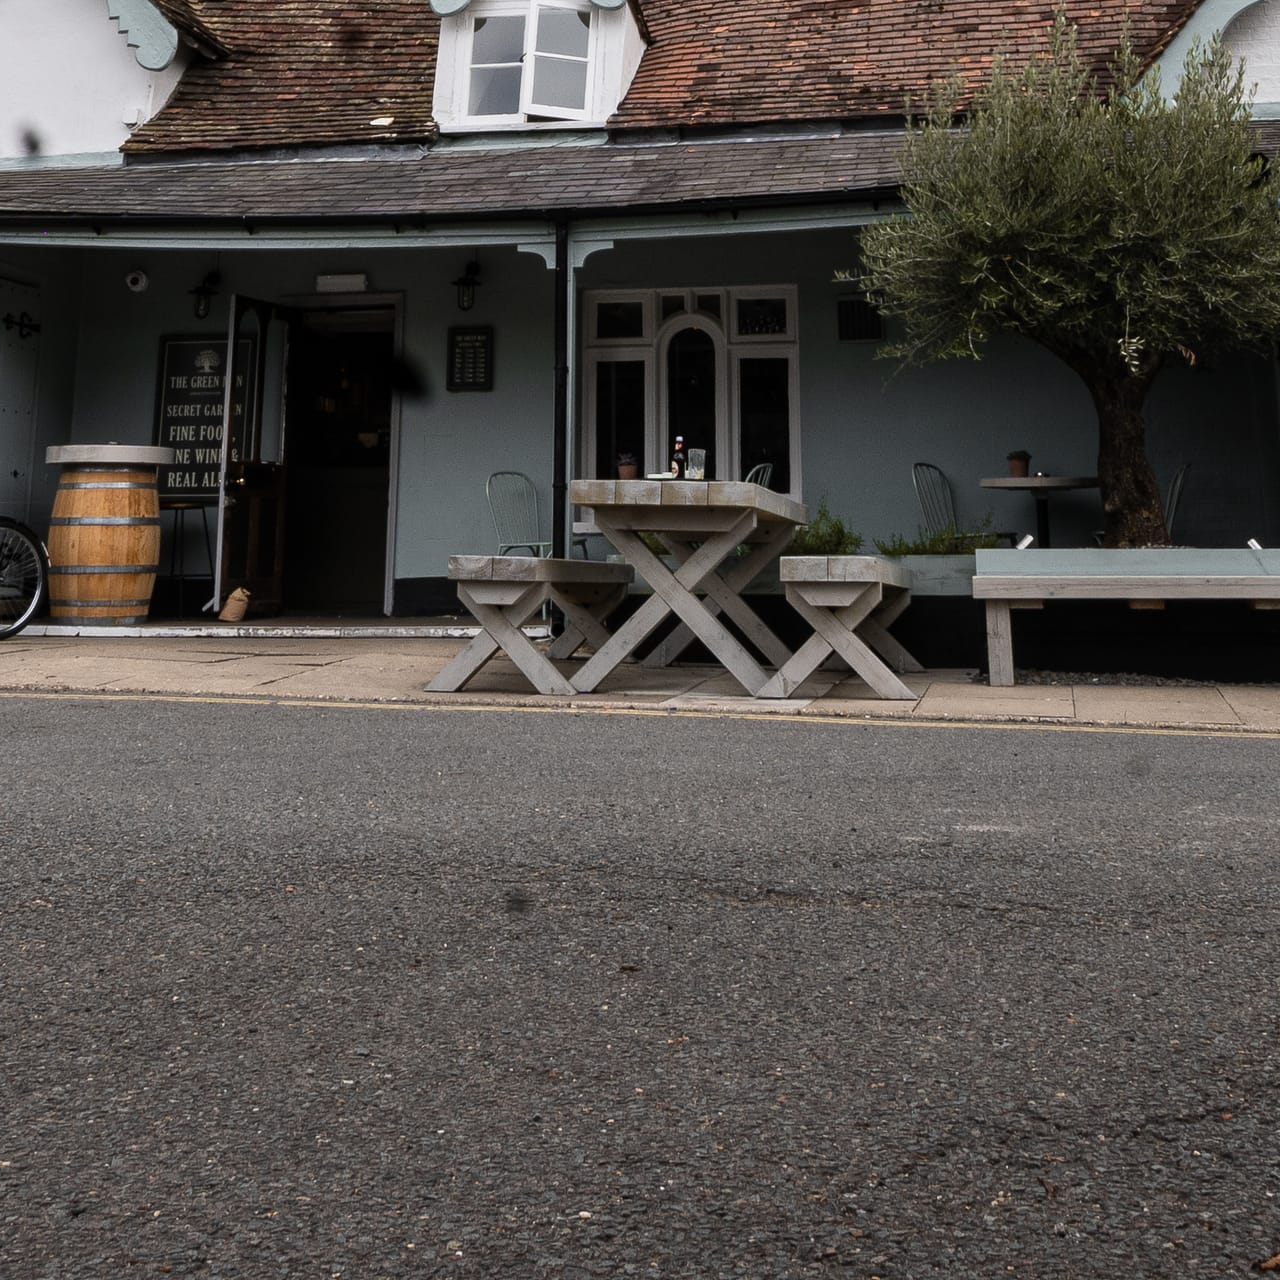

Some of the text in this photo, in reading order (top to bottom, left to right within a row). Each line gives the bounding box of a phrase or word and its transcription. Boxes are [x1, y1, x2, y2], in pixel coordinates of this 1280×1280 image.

[170, 376, 188, 389] THE
[190, 375, 220, 388] GREEN
[166, 404, 242, 417] SECRET GARN
[169, 425, 236, 442] FINE FOO,
[175, 449, 191, 464] NE
[231, 448, 239, 462] &
[167, 472, 198, 488] REAL
